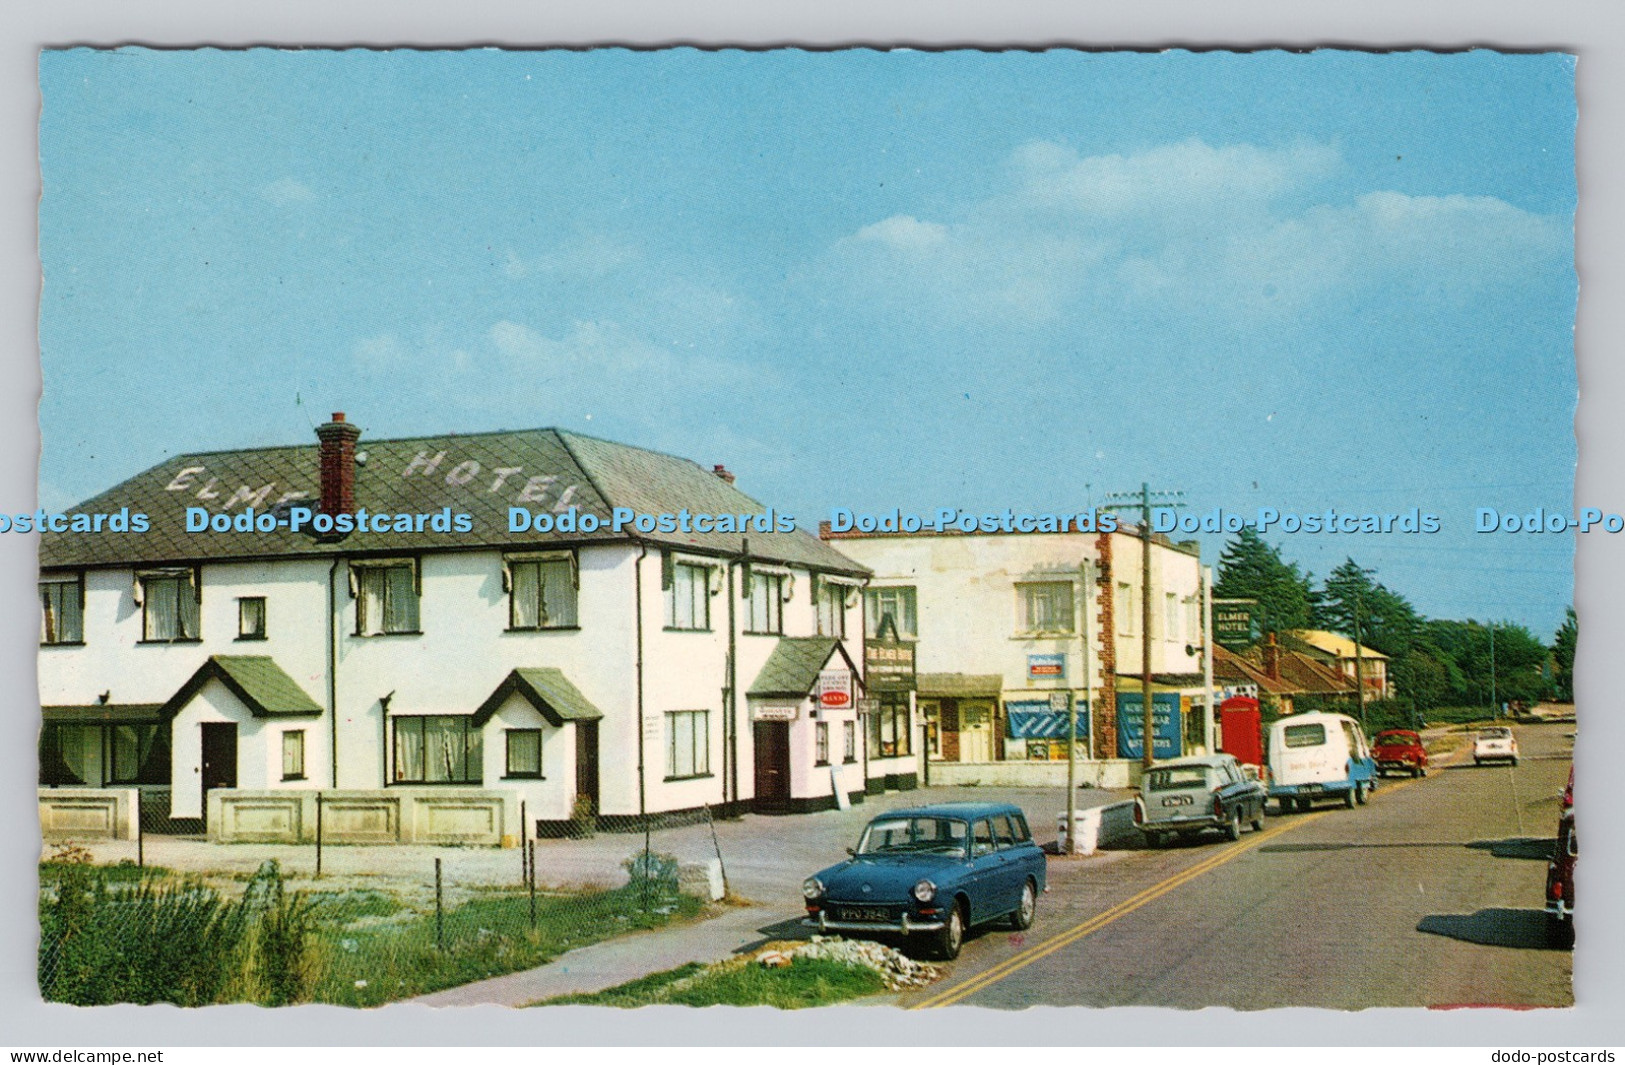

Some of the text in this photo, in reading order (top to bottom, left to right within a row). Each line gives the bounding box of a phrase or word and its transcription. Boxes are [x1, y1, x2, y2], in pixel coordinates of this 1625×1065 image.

[402, 450, 582, 513] HOTEL
[1218, 612, 1250, 621] ELMER
[1218, 622, 1250, 631] HOTEL
